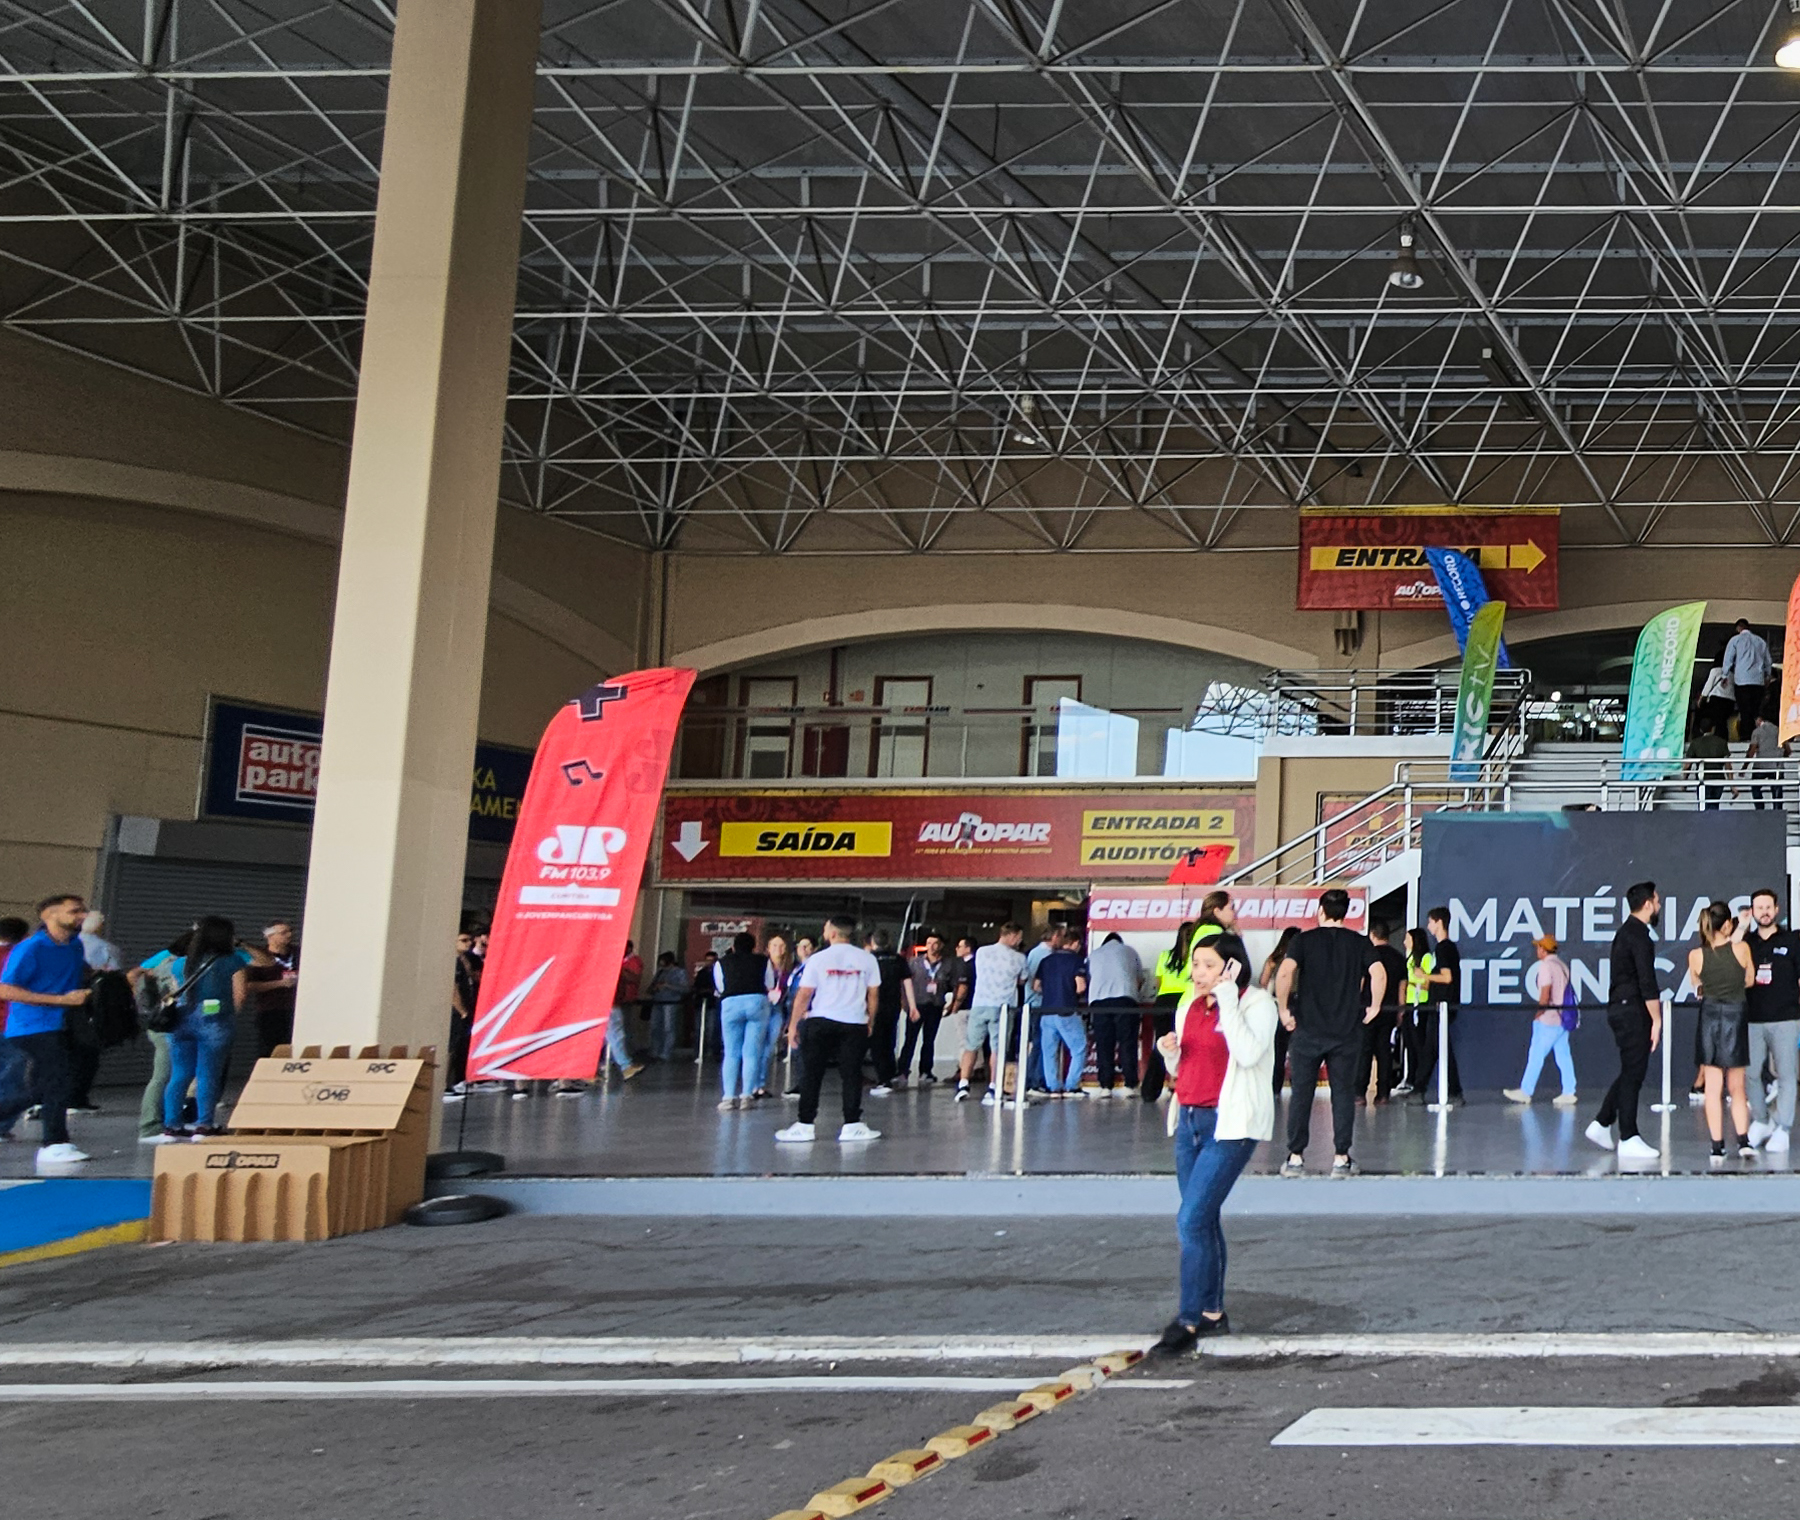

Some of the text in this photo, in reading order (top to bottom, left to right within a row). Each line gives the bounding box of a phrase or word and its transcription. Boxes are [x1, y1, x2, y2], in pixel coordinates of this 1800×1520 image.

[1335, 548, 1481, 567] ENTRAA
[1394, 583, 1442, 597] AUTOP
[1661, 616, 1680, 679] RECORD
[249, 741, 322, 767] auto
[919, 814, 1052, 848] AUTOPAR
[1091, 816, 1225, 830] ENTRADA 2
[756, 827, 856, 852] SAÍDA
[539, 865, 612, 880] FM 103.9
[282, 1062, 313, 1073] RPC
[366, 1063, 399, 1074] RPC
